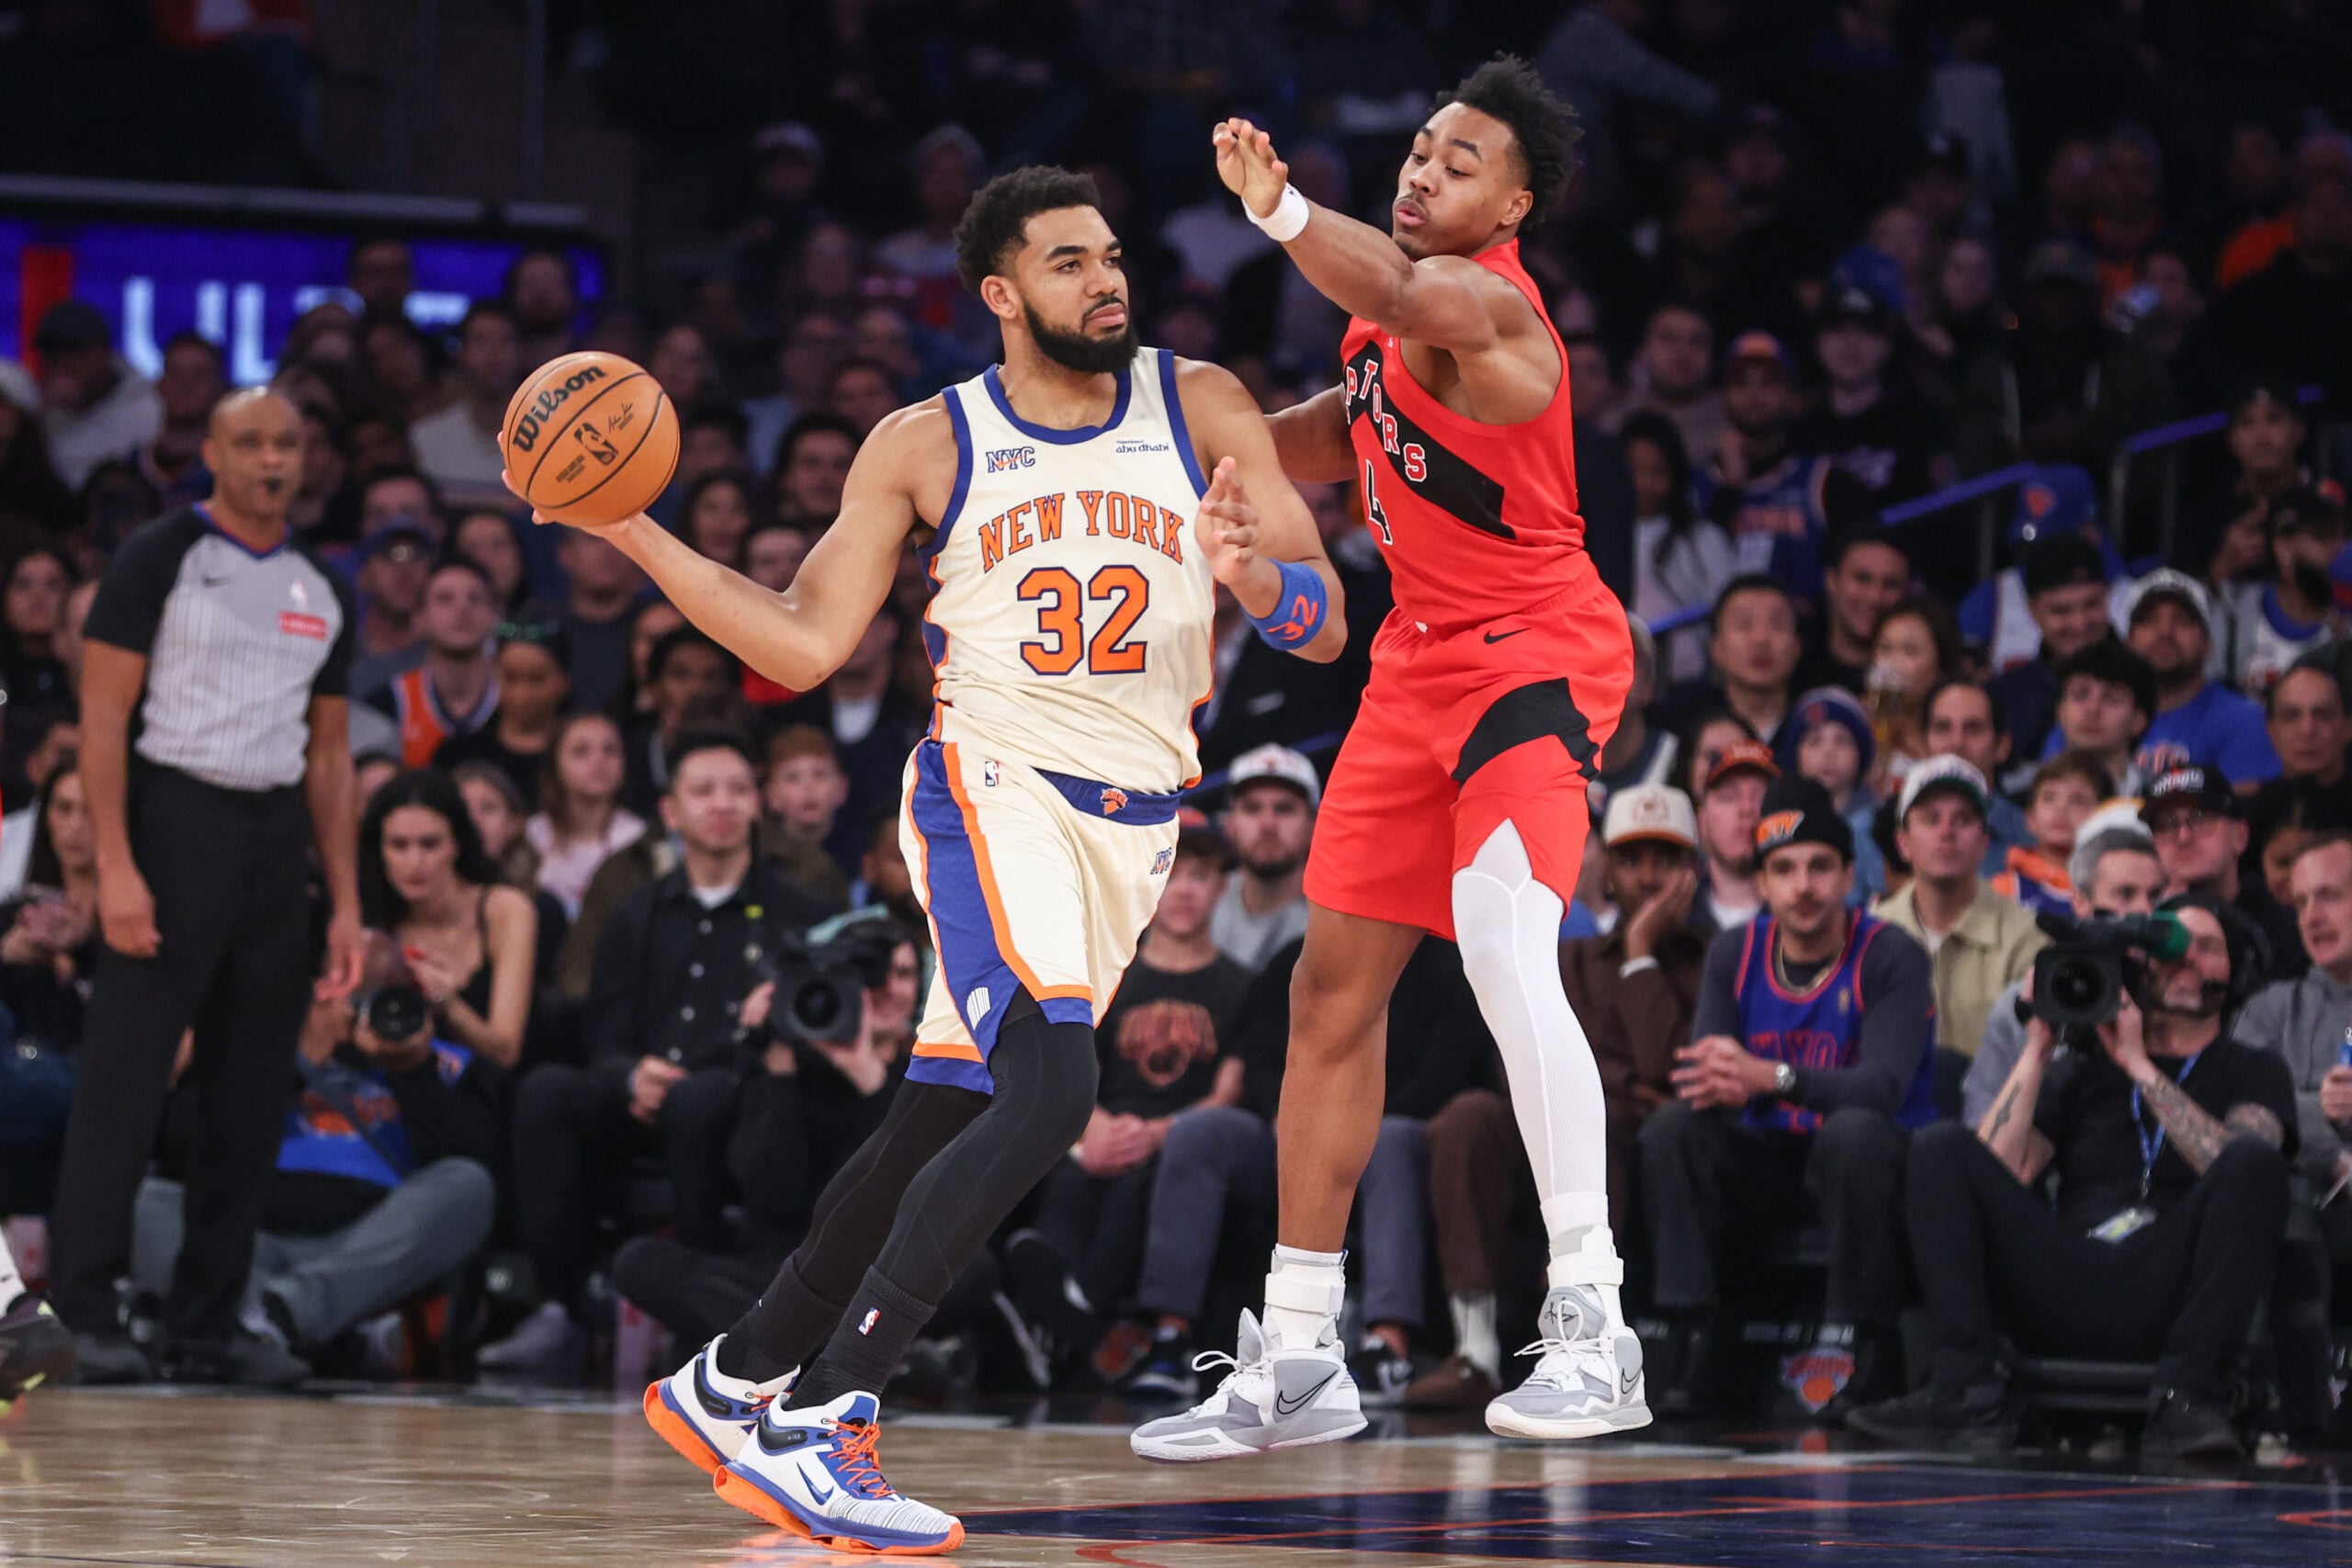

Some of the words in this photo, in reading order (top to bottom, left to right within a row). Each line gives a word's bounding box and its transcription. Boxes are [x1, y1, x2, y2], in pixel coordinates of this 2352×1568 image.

[512, 366, 607, 453] Wilson
[1116, 446, 1136, 454] abu
[1138, 443, 1170, 452] dhabi
[1343, 359, 1428, 482] PTORS
[986, 446, 1035, 473] NYC
[1365, 458, 1394, 546] 4
[978, 492, 1066, 574] NEW
[1077, 491, 1184, 566] YORK
[1017, 565, 1149, 675] 32
